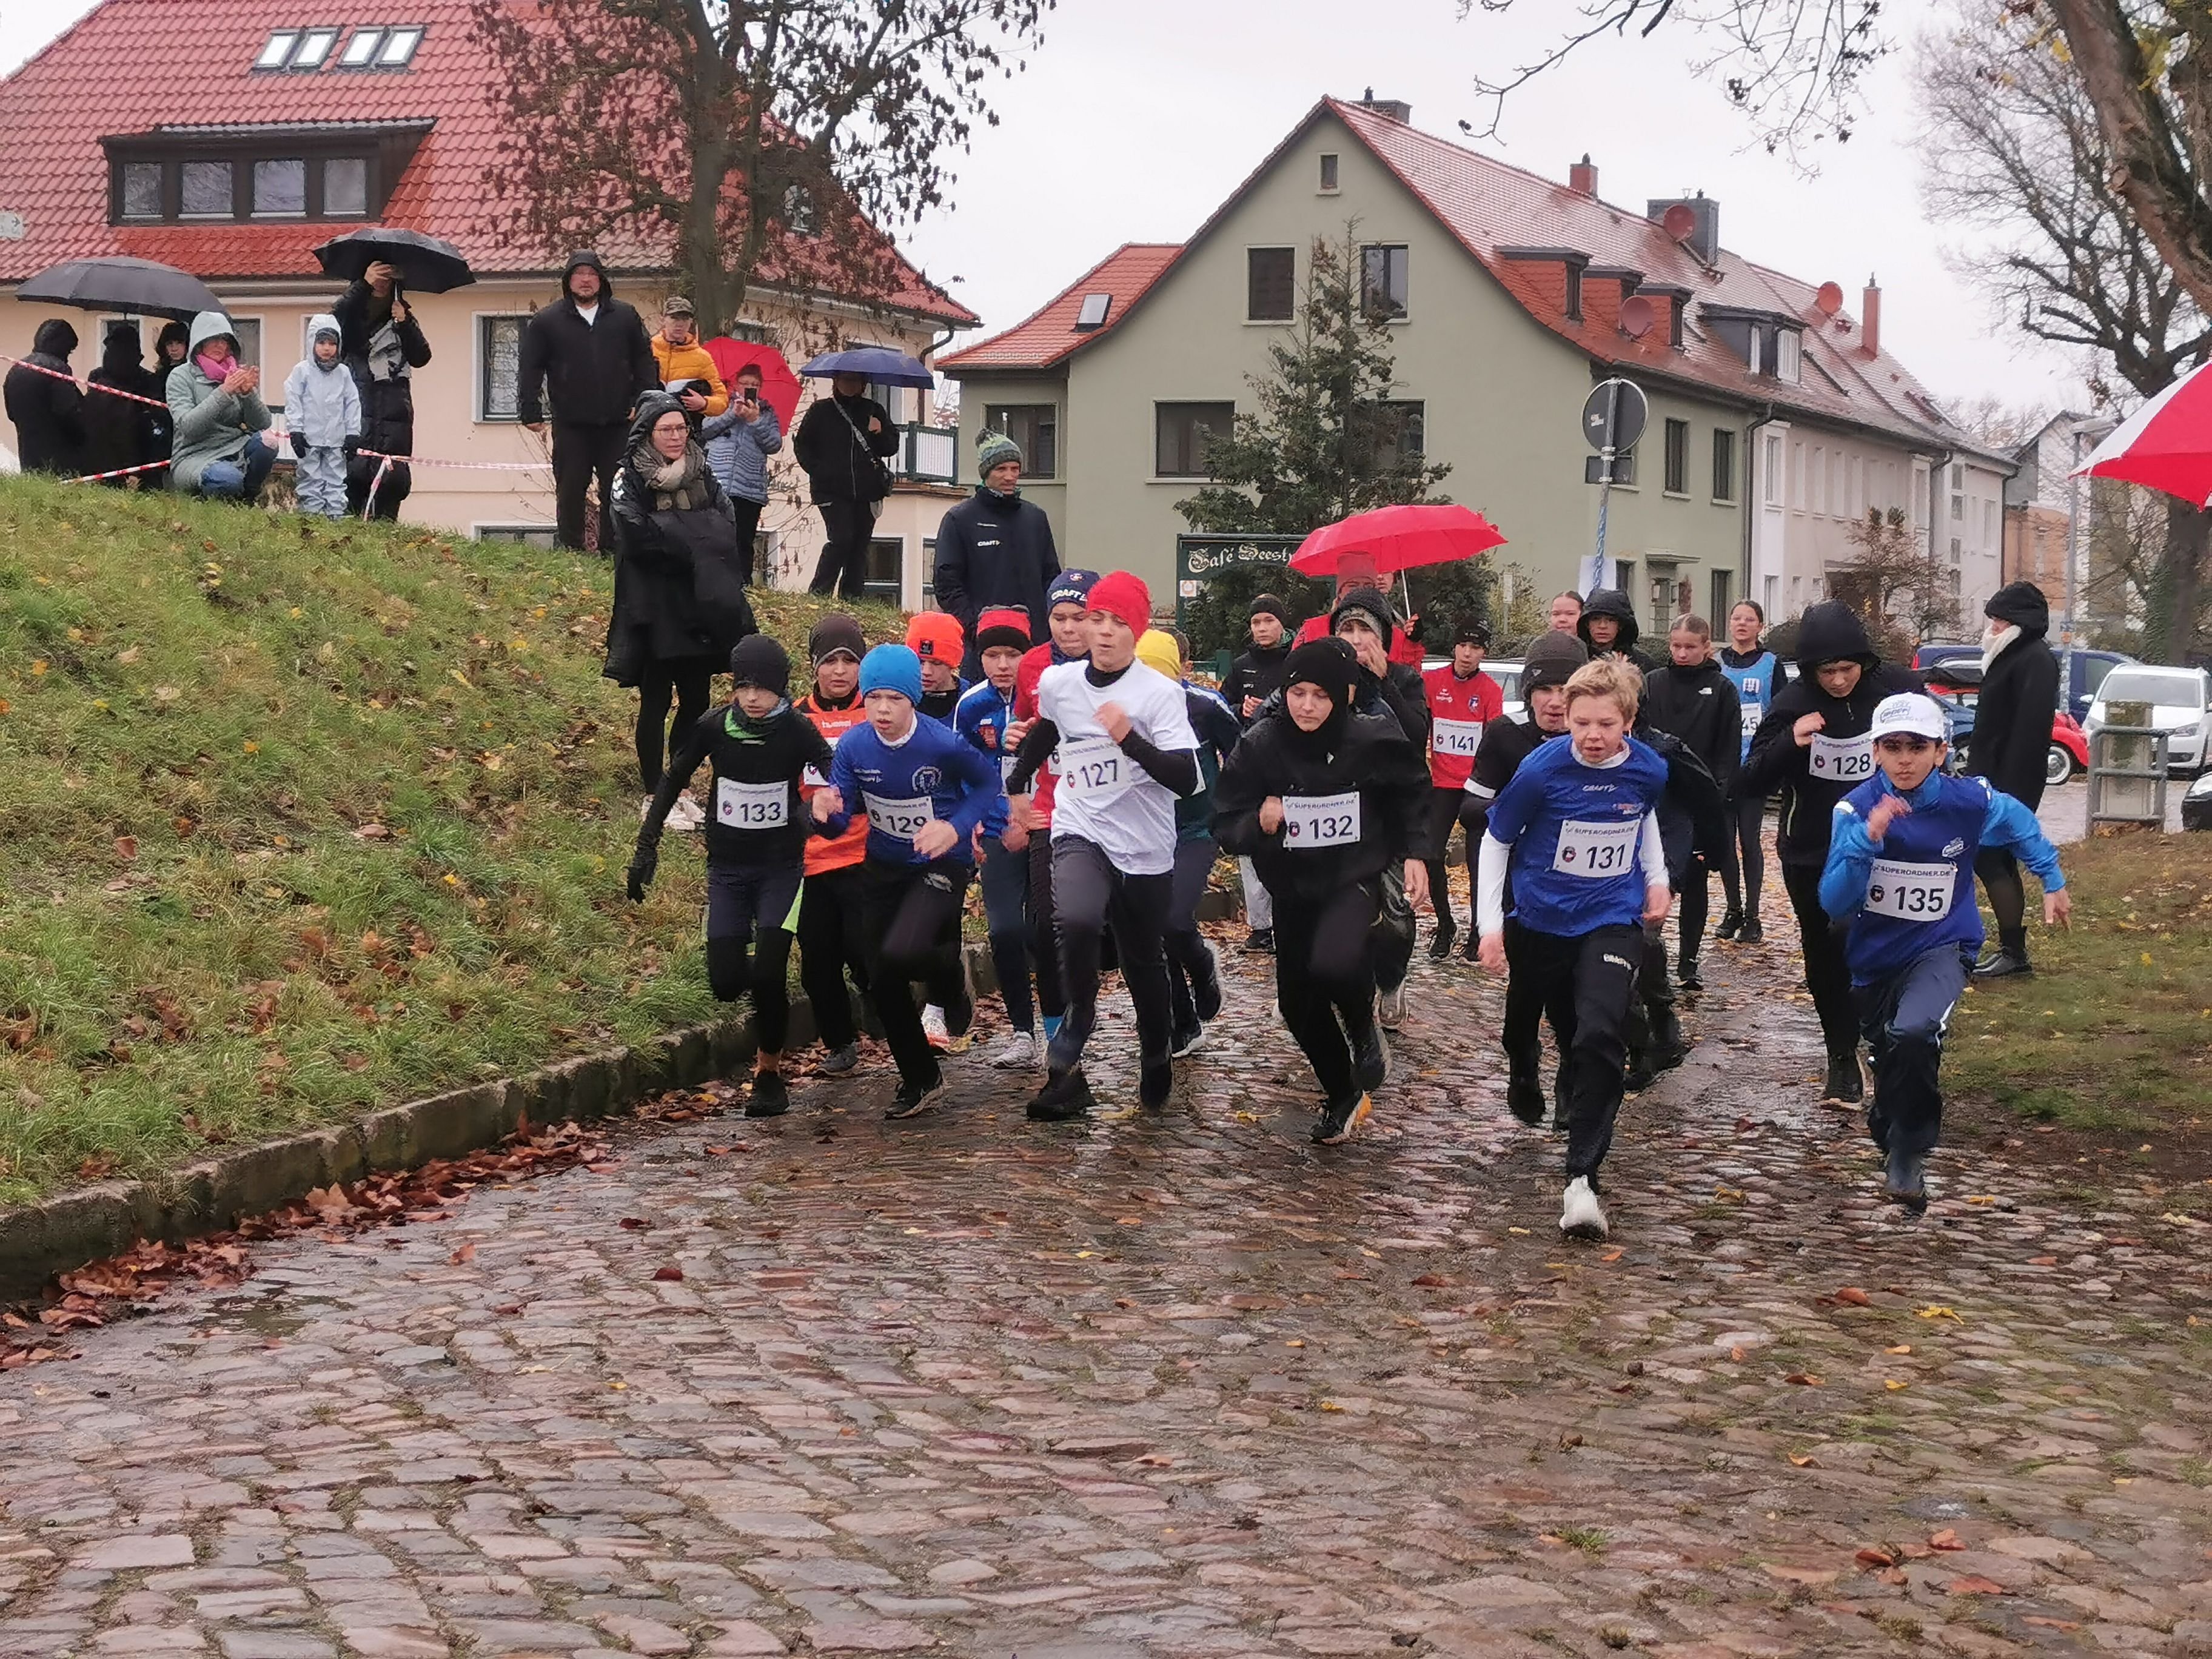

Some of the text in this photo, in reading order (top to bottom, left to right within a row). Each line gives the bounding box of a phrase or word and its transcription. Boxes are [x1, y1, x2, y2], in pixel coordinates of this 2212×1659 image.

[1188, 547, 1235, 573] Café
[1449, 735, 1474, 751] 141
[1079, 759, 1118, 788] 127
[1832, 752, 1871, 775] 128
[740, 802, 781, 822] 133
[886, 815, 928, 834] 129
[1309, 815, 1353, 840] 132
[1586, 843, 1626, 870] 131
[1880, 865, 1951, 877] SUPERORDNER.DE
[1893, 886, 1945, 913] 135
